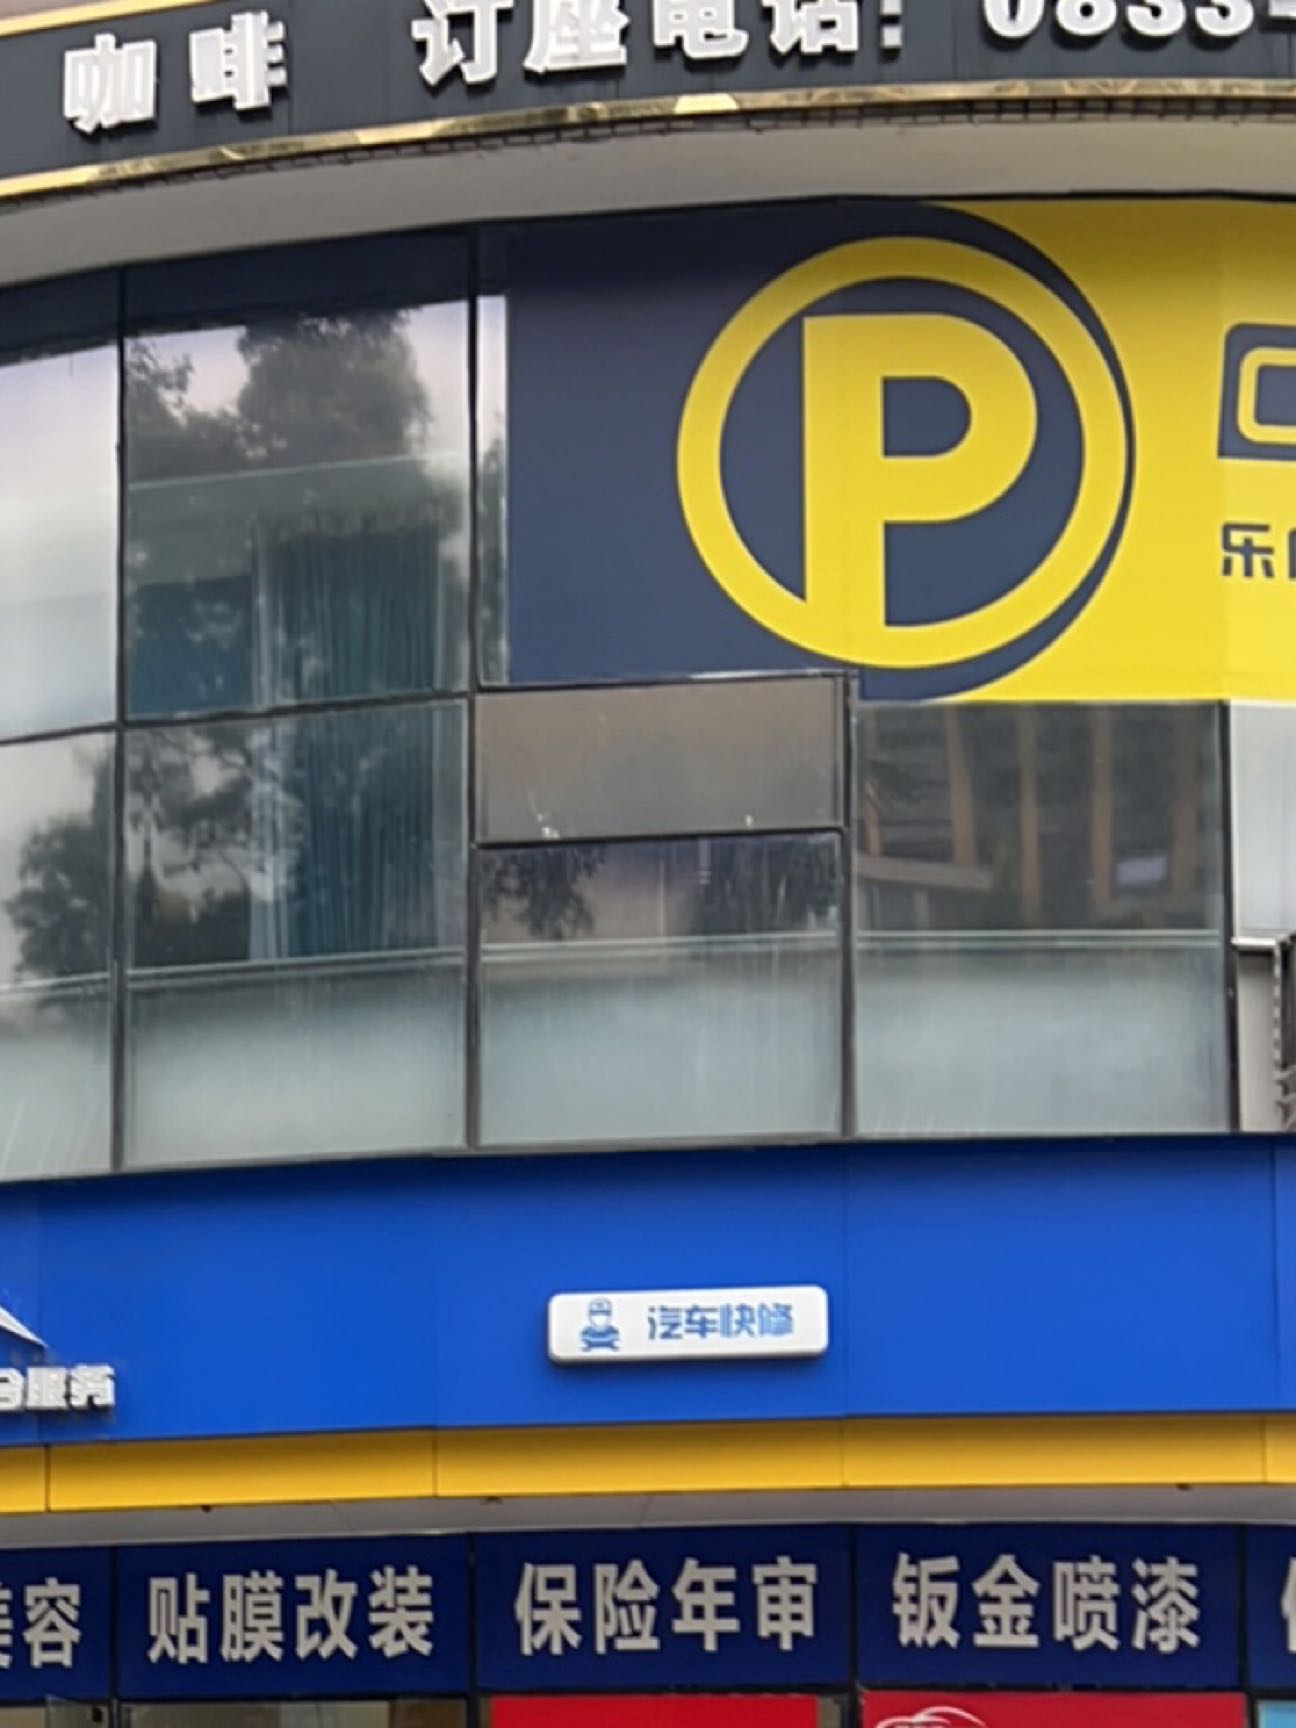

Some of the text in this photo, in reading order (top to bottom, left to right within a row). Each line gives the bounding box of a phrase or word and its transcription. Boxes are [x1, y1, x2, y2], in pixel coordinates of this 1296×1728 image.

[64, 10, 287, 134] 咖啡
[803, 314, 1038, 642] P
[648, 1303, 793, 1340] 汽车快修
[148, 1565, 434, 1665] 贴膜改装
[513, 1556, 819, 1655] 保险年审
[893, 1552, 1201, 1653] 钣金喷漆
